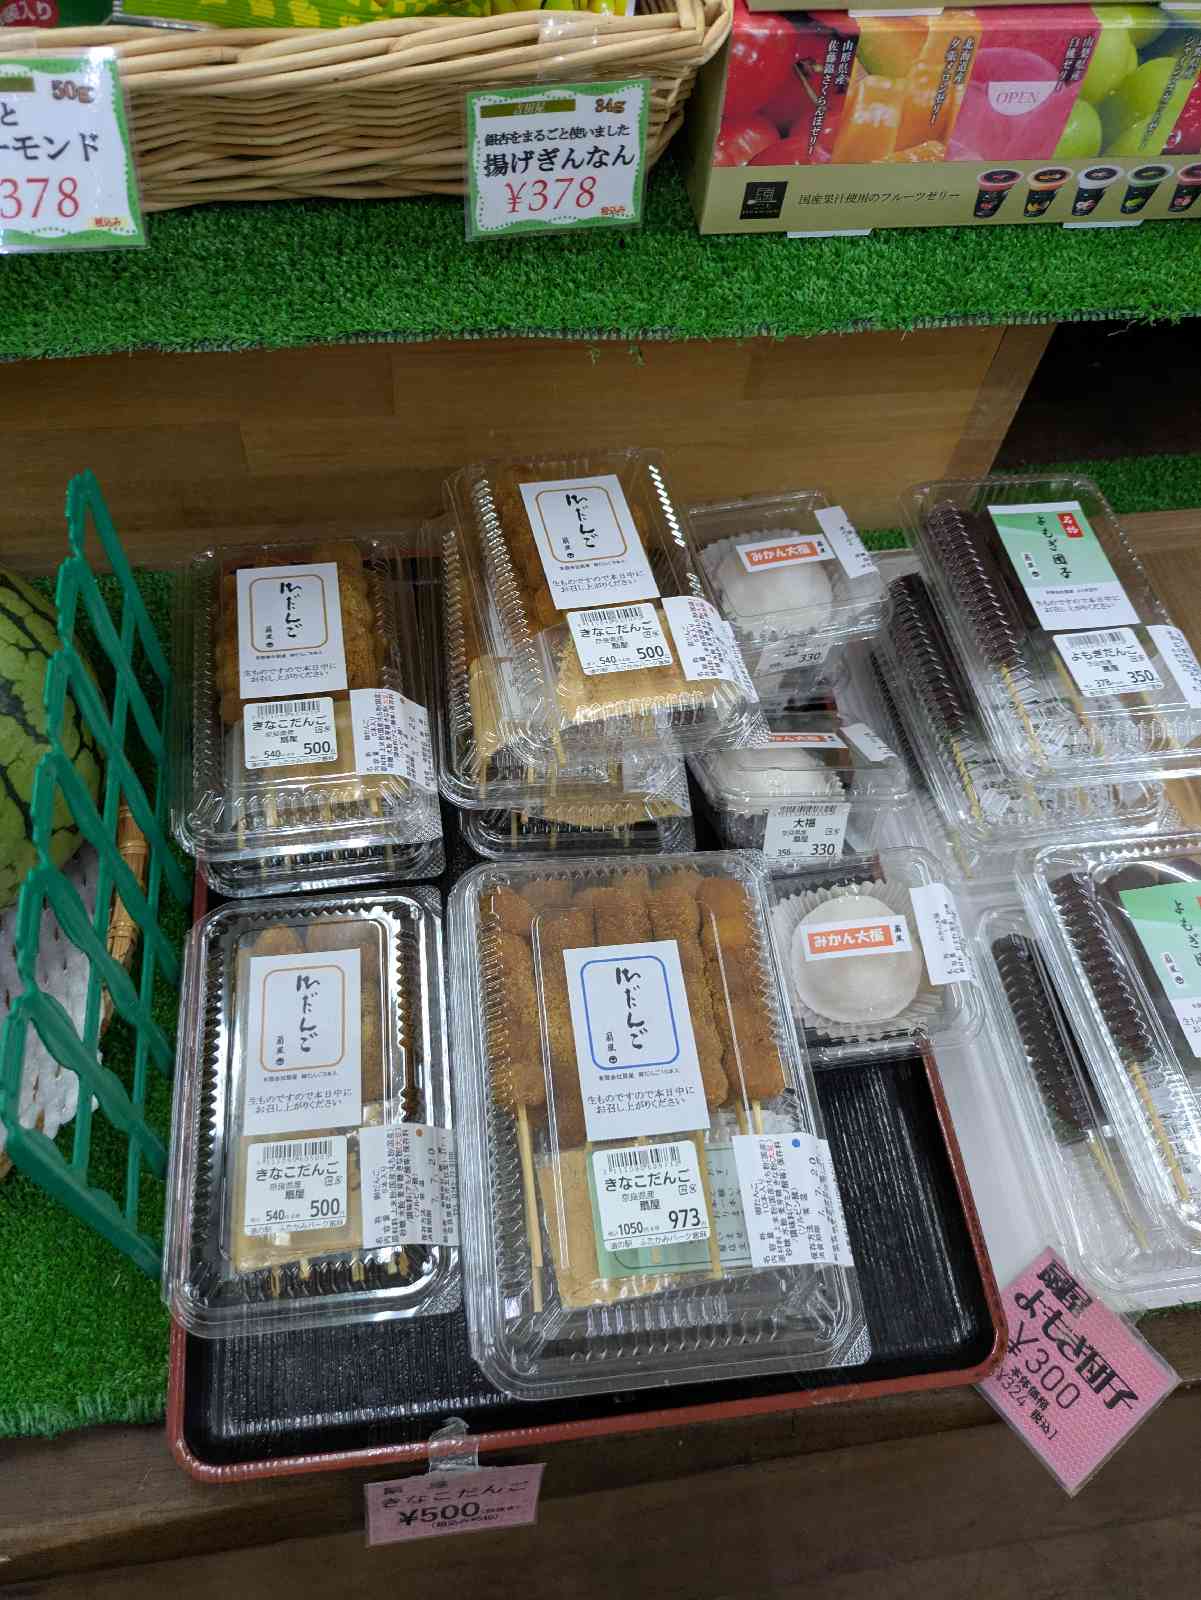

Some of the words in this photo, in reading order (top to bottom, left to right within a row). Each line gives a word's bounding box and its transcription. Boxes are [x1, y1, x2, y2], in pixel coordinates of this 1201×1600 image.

[996, 90, 1038, 105] OPEN
[484, 124, 631, 147] 銀杏をまるごと使いました
[483, 144, 636, 178] 揚げぎんなん
[0, 176, 79, 220] 378
[504, 176, 598, 214] ¥378
[798, 191, 961, 206] 国産果汁使用のフルーツゼリー
[751, 545, 811, 561] みかん大福
[579, 620, 654, 638] きなこだんご
[599, 655, 617, 665] 540
[636, 645, 665, 660] 500
[1071, 645, 1137, 663] よもぎだんご
[1127, 670, 1154, 683] 350
[252, 715, 327, 731] きなこだんご
[263, 750, 281, 759] 540
[303, 741, 331, 756] 500
[793, 818, 816, 828] 大福
[810, 843, 835, 856] 330
[813, 928, 886, 947] みかん大福
[248, 1088, 352, 1106] 生ものですので本日中に
[588, 1086, 695, 1106] 生ものですので本日中に
[256, 1098, 342, 1114] お召し上がりください
[596, 1098, 688, 1114] お召し上がりください
[255, 1161, 339, 1182] きなこだんご
[604, 1168, 691, 1193] きなこだんご
[265, 1208, 285, 1221] 540
[310, 1198, 341, 1218] 500
[617, 1221, 644, 1235] 1050
[668, 1208, 701, 1230] 973
[1014, 1289, 1138, 1410] よもぎ団子
[1007, 1321, 1080, 1409] ¥300
[383, 1480, 529, 1510] きなこだんご
[399, 1502, 480, 1526] ¥500
